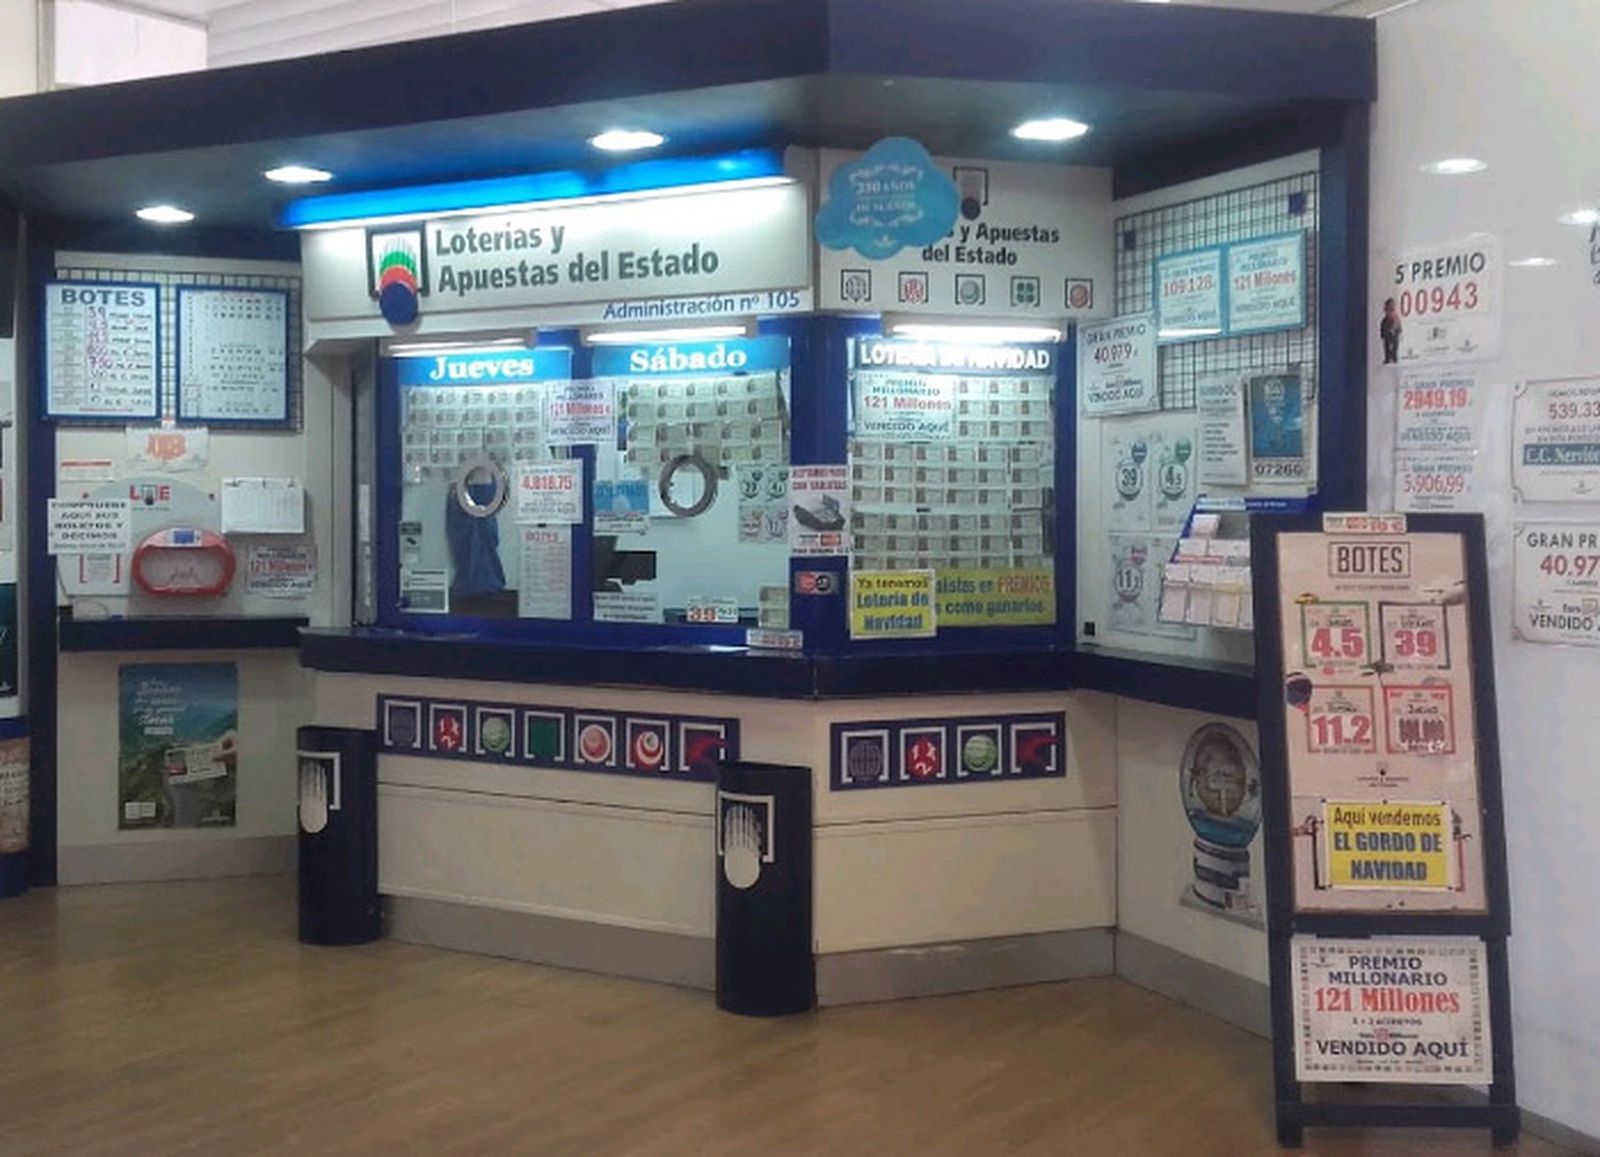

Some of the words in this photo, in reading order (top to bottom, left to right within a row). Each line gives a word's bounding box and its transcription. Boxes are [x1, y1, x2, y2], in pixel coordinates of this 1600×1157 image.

[435, 222, 543, 256] Loterías
[551, 226, 566, 254] y
[960, 225, 971, 244] y
[976, 222, 1060, 245] Apuestas
[922, 244, 950, 262] del
[955, 246, 1018, 266] Estado
[1412, 251, 1486, 283] PREMIO
[438, 258, 560, 297] Apuestas
[568, 243, 609, 283] del
[618, 243, 720, 279] Estado
[61, 288, 147, 307] BOTES
[603, 296, 735, 320] Administración
[767, 291, 801, 308] 105
[1400, 282, 1479, 317] 00943
[429, 356, 535, 381] Jueves
[629, 343, 747, 373] Sábado
[1526, 532, 1574, 548] GRAN
[1578, 533, 1597, 548] PR
[1337, 546, 1403, 573] BOTES
[1540, 554, 1600, 577] 40.97
[945, 600, 984, 614] como
[1529, 614, 1593, 631] VENDIDO
[1311, 628, 1364, 658] 4.5
[1394, 630, 1437, 657] 39
[1311, 715, 1371, 745] 11.2
[1368, 808, 1441, 826] vendemos
[1334, 831, 1351, 851] EL
[1355, 831, 1415, 852] GORDO
[1420, 832, 1443, 852] DE
[1351, 859, 1427, 880] NAVIDAD
[1350, 955, 1422, 970] PREMIO
[1328, 971, 1448, 986] MILLONARIO
[1315, 987, 1351, 1012] 121
[1361, 987, 1461, 1014] Millones
[1316, 1039, 1407, 1056] VENDIDO
[1413, 1036, 1469, 1060] AQUÍ
